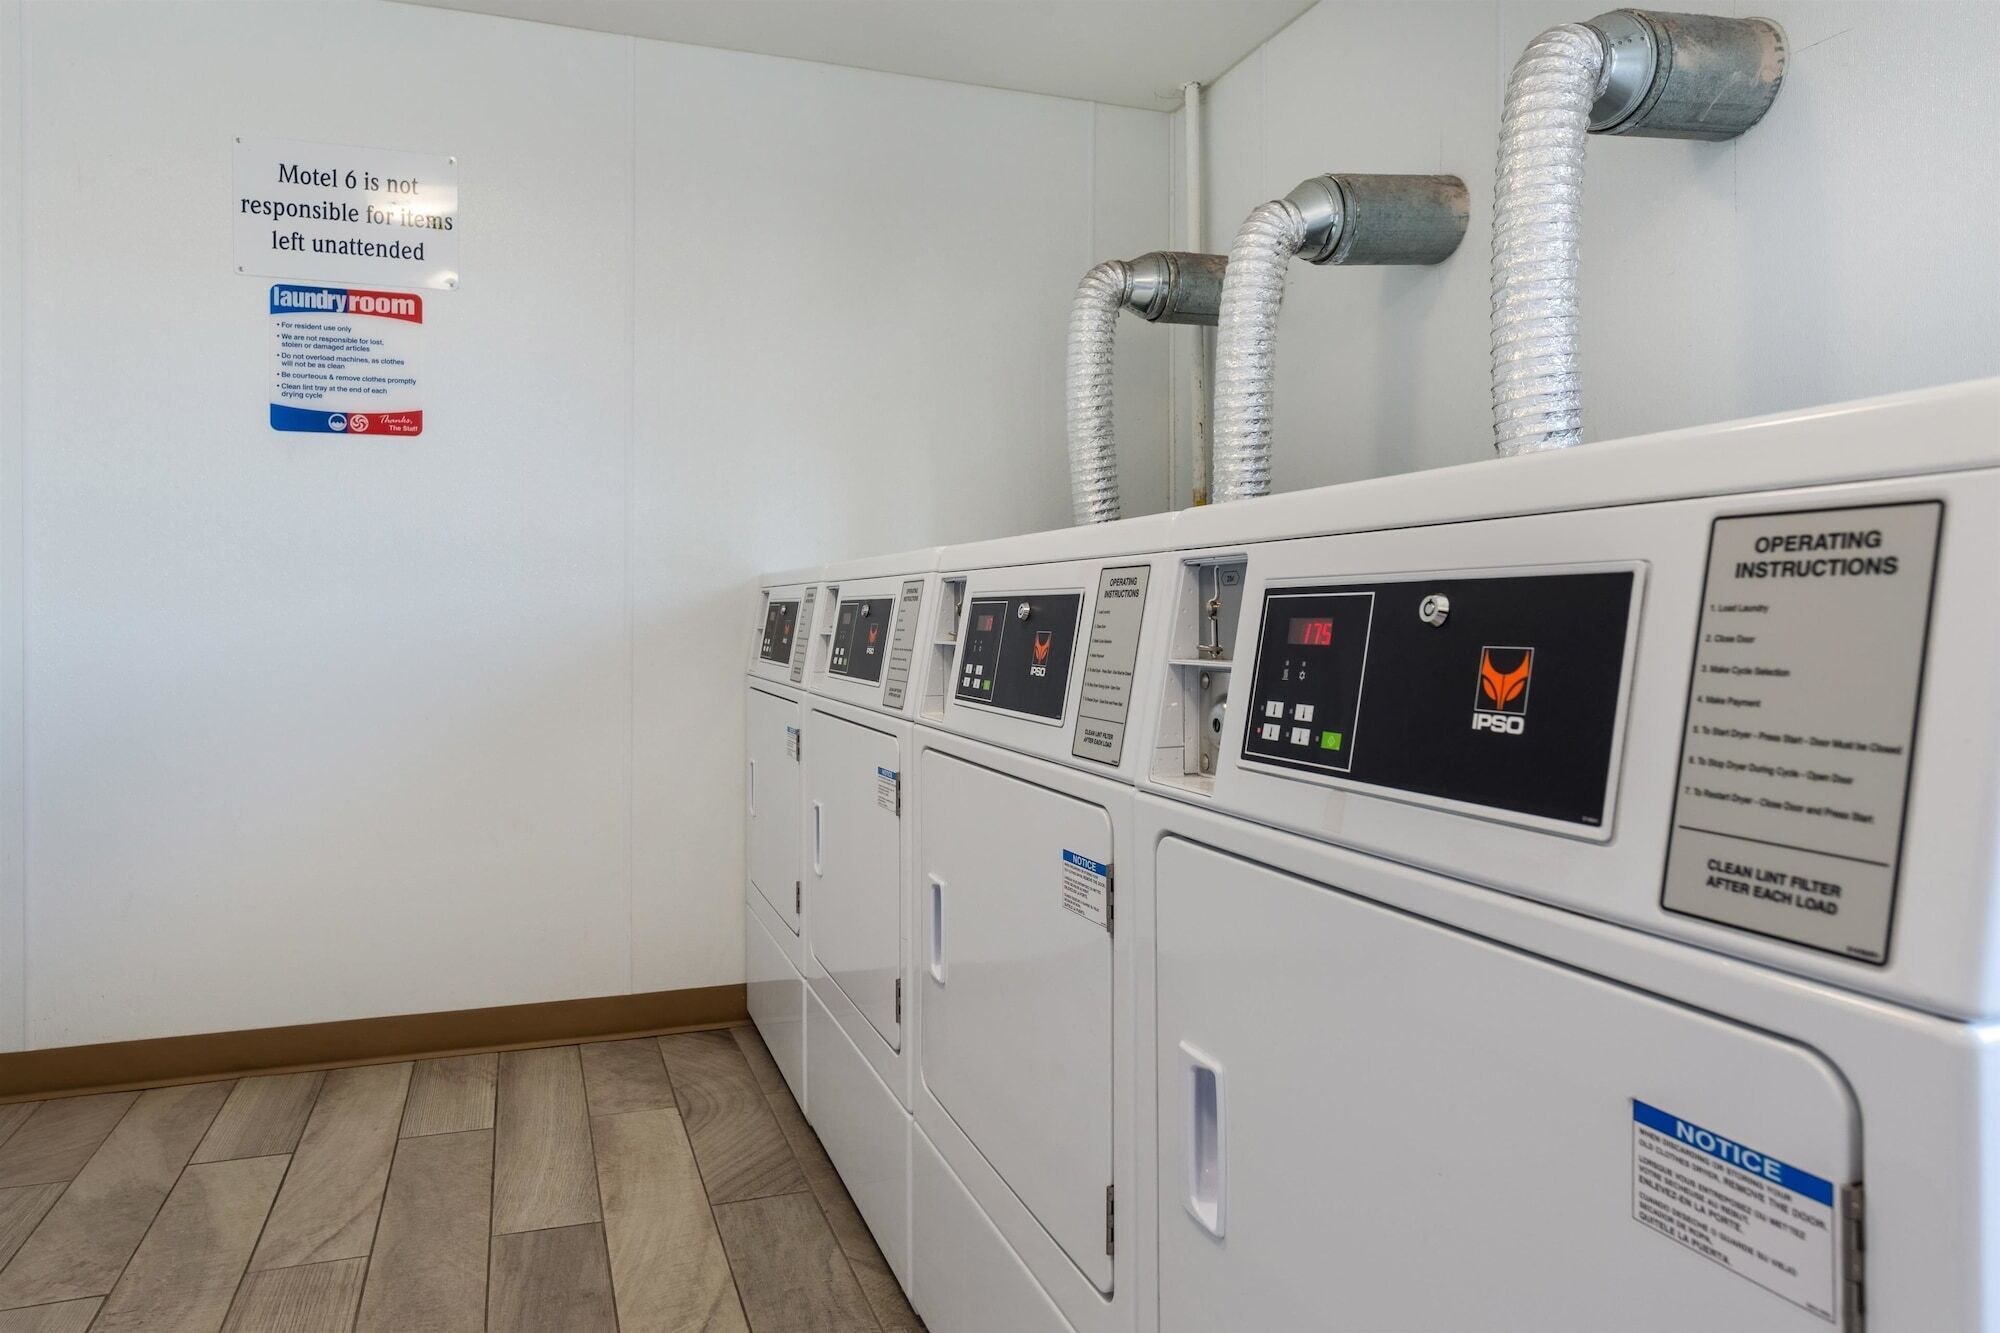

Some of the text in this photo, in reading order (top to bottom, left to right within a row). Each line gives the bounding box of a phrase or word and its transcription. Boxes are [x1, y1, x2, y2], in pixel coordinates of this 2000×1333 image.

[279, 164, 419, 194] Motel 6 is not
[241, 198, 453, 230] responsible for items
[272, 231, 424, 260] left unattended
[388, 377, 416, 385] promptly
[1754, 530, 1882, 553] OPERATING
[1734, 556, 1899, 578] INSTRUCTIONS
[1304, 623, 1332, 645] 175
[1030, 666, 1046, 676] IPSO
[1472, 713, 1525, 735] IPSO
[1073, 855, 1096, 871] NOTICE
[1706, 858, 1841, 898] CLEAN LINT FILTER
[1705, 875, 1838, 916] AFTER EACH LOAD
[1676, 1120, 1781, 1183] NOTICE
